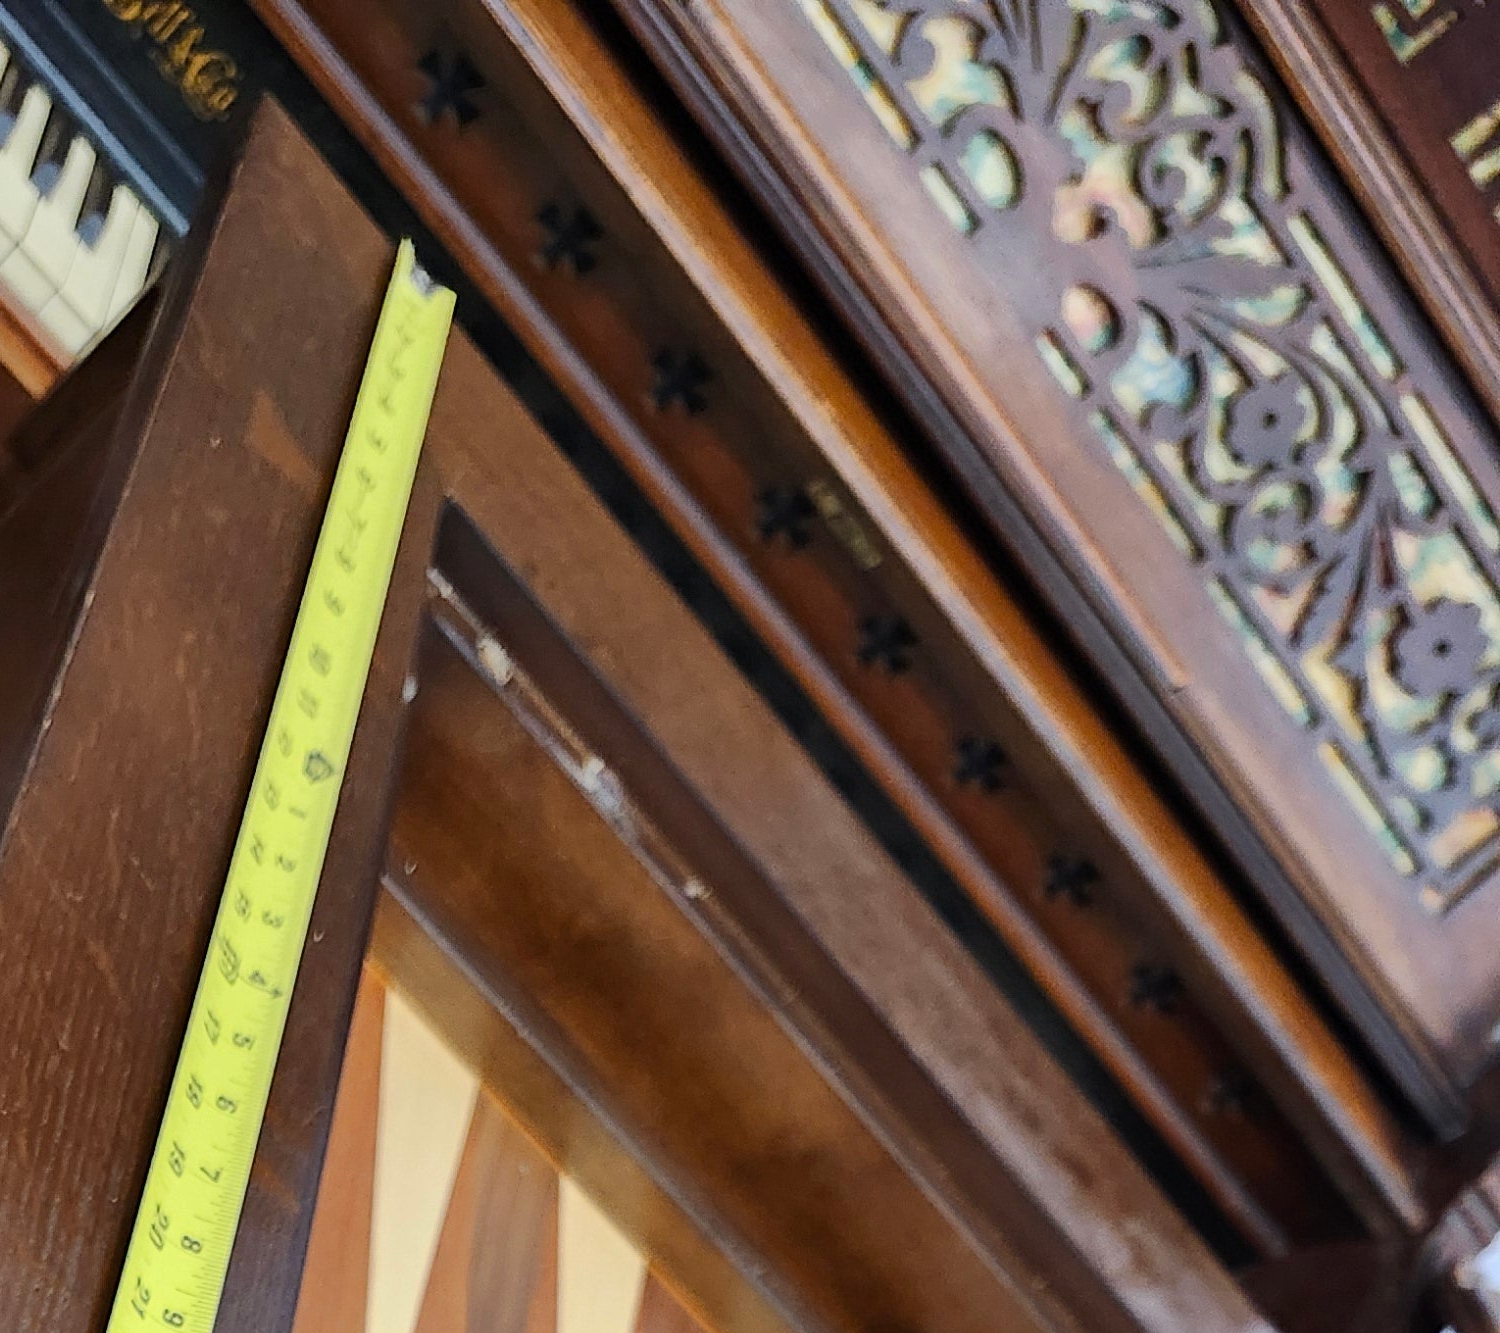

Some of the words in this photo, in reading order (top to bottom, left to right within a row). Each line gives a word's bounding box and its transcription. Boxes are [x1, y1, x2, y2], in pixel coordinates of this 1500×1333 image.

[262, 911, 284, 929] 3
[204, 1007, 221, 1046] 17
[232, 1032, 255, 1051] 5
[216, 1095, 237, 1114] 6
[168, 1139, 187, 1178] 19
[200, 1165, 221, 1183] 7
[148, 1204, 170, 1251] 20
[180, 1235, 203, 1254] 8
[131, 1275, 152, 1319] 21
[162, 1308, 185, 1329] 9
